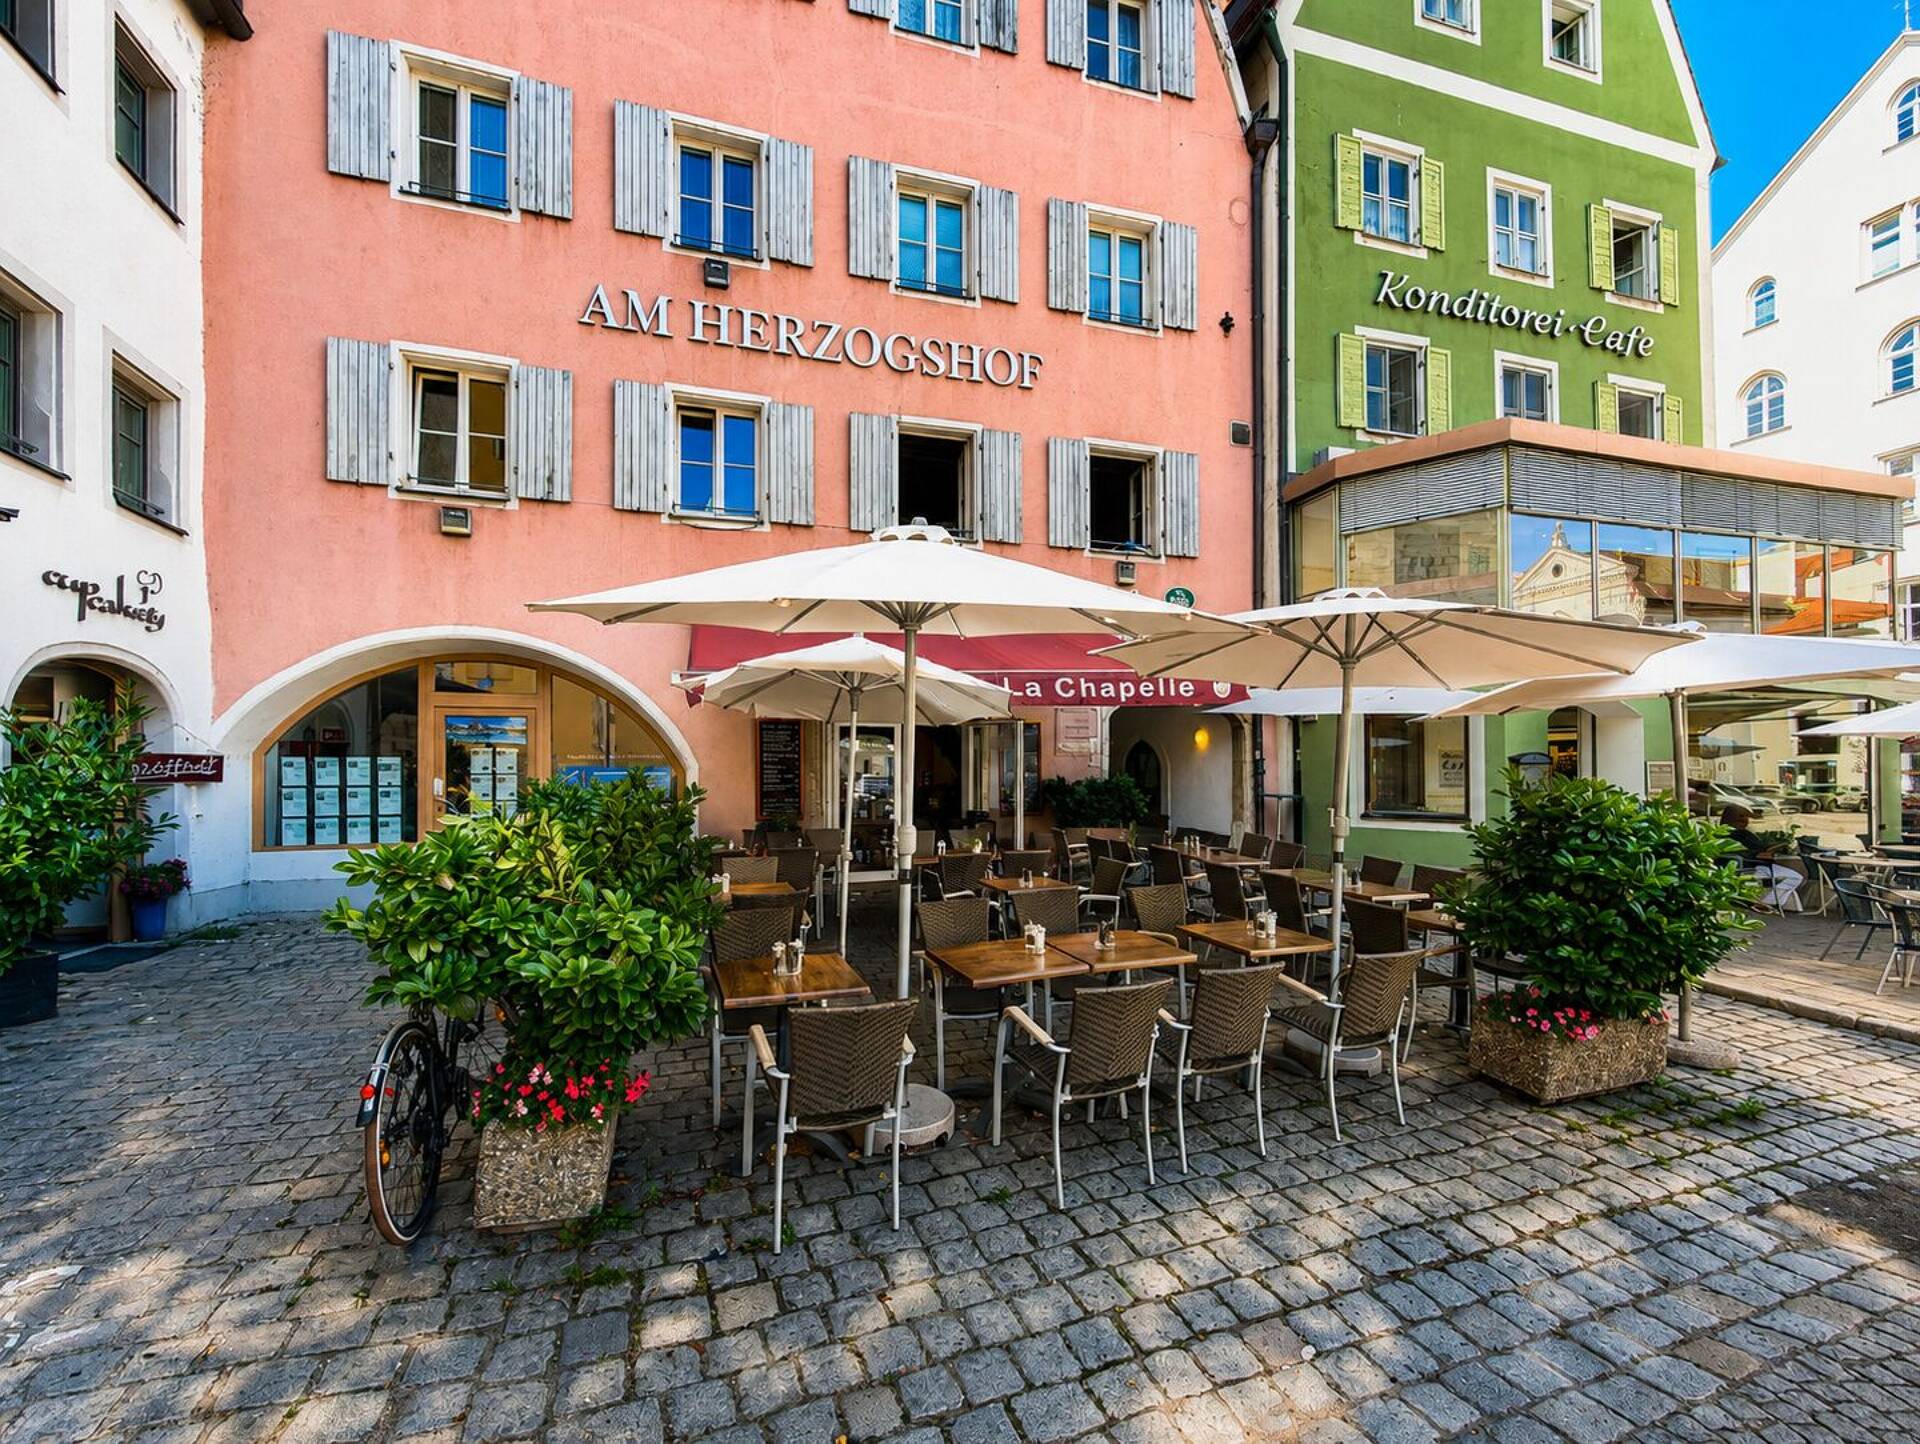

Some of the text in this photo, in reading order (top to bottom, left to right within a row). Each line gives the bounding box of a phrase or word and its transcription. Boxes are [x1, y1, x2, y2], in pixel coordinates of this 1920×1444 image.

[578, 284, 1044, 389] AM HERZOGSHOF
[1004, 677, 1195, 702] La Chapelle
